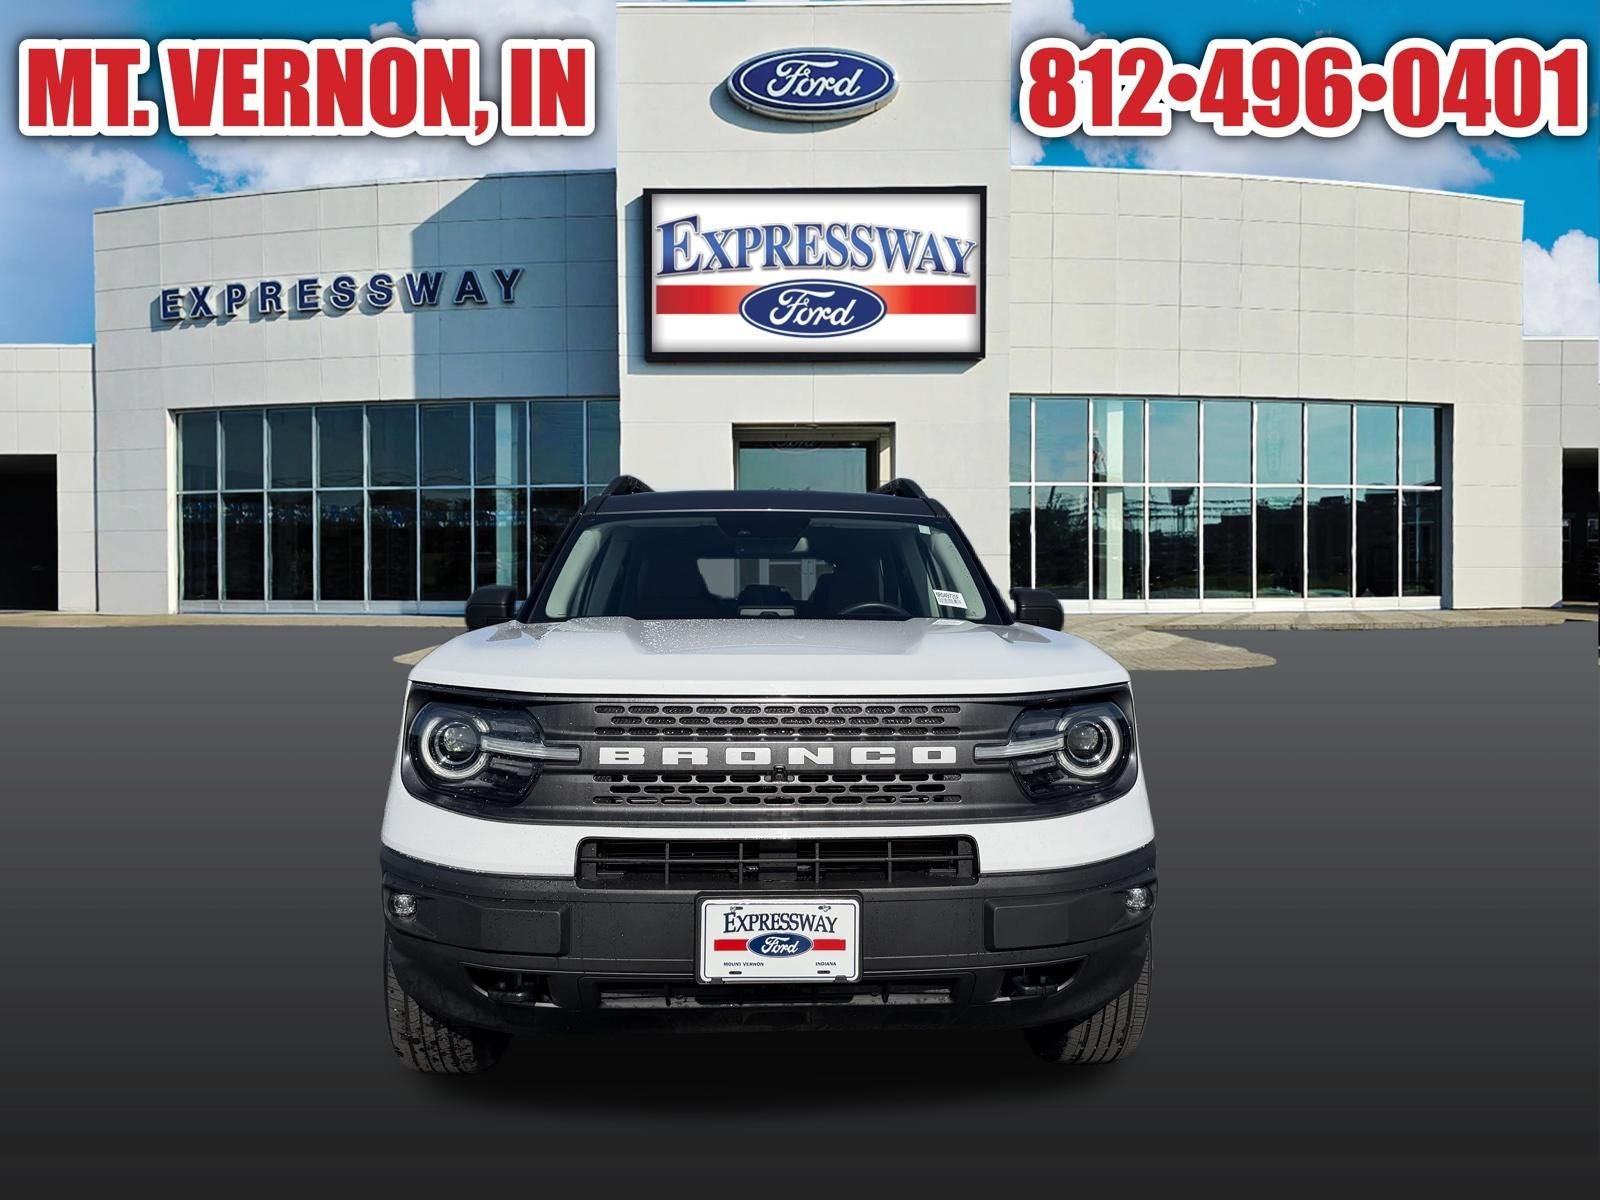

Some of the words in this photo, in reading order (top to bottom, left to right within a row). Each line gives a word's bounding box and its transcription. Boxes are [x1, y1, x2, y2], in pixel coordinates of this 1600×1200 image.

[766, 59, 863, 98] Ford
[656, 214, 977, 278] EXPRESSWAY
[159, 268, 526, 321] EXPRESSWAY
[769, 287, 858, 327] Ford
[599, 746, 957, 765] BRONCO
[723, 911, 838, 934] EXPRESSWAY
[761, 936, 799, 954] Ford
